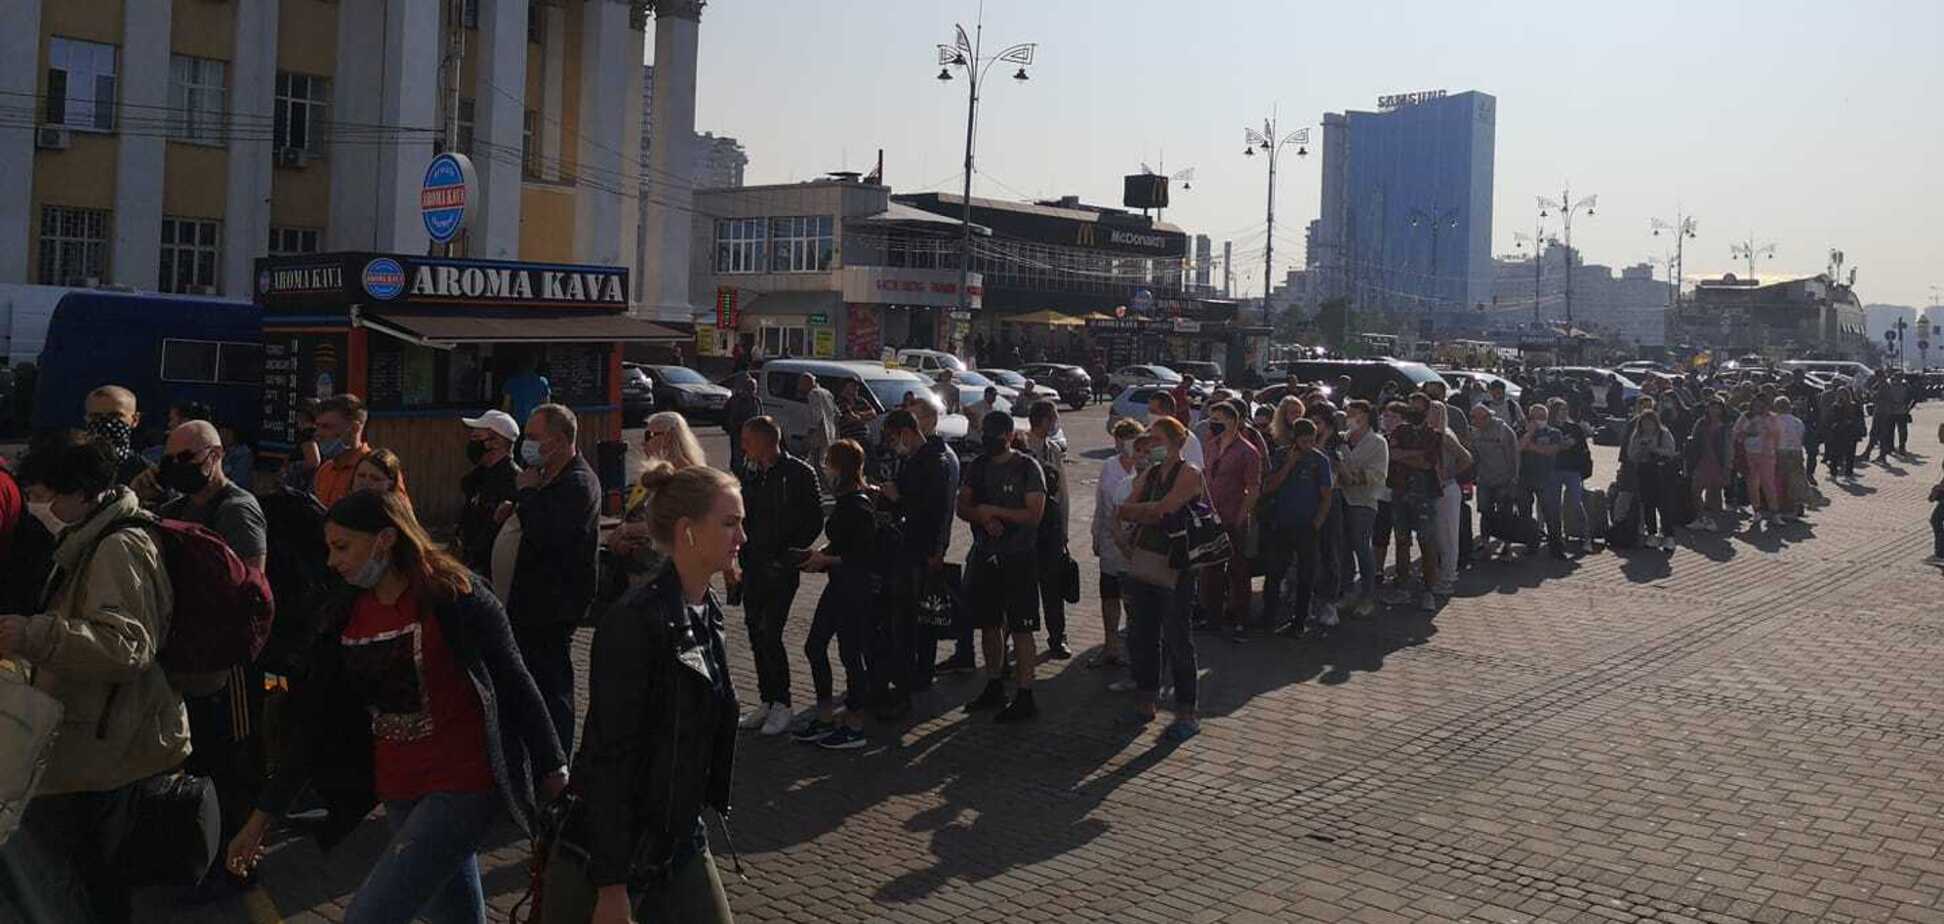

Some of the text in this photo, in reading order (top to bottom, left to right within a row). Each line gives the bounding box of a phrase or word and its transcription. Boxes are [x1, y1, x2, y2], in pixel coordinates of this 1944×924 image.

[274, 269, 311, 289] AROMA
[312, 267, 343, 288] KAVA
[411, 265, 625, 302] AROMA KAVA
